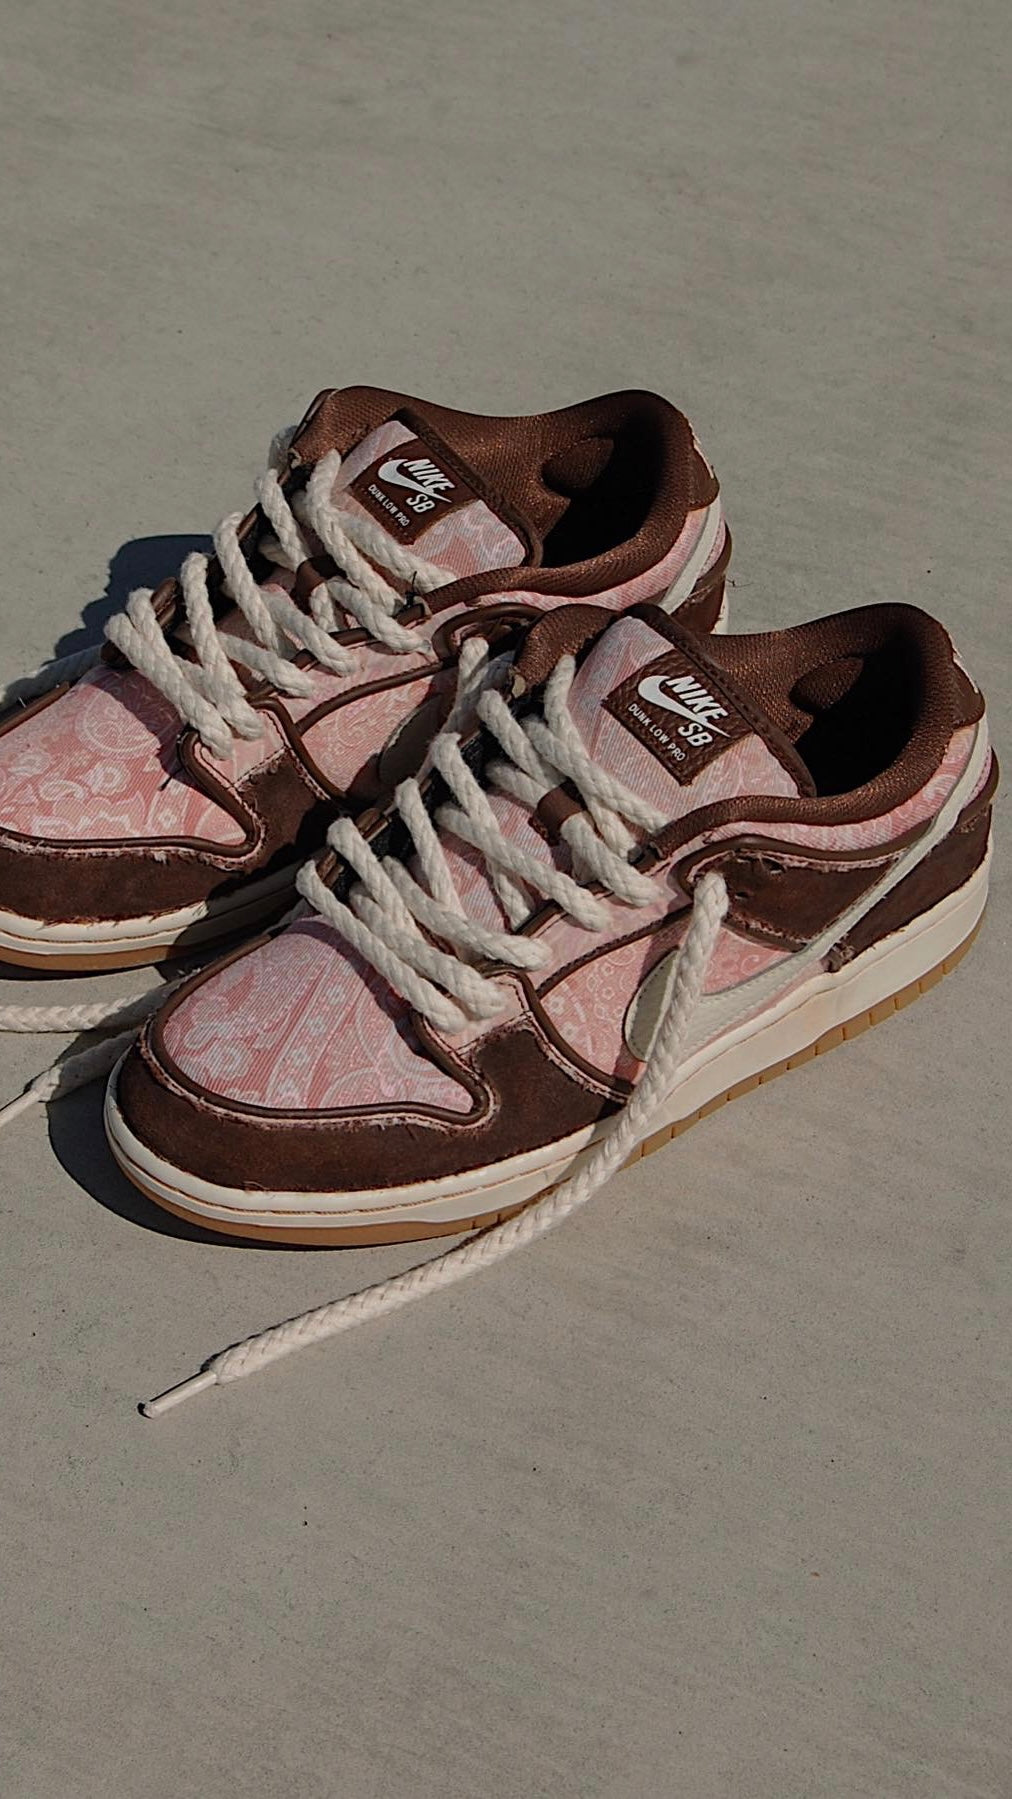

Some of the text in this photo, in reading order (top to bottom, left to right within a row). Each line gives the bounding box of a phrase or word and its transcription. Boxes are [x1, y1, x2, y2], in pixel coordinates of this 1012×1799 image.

[402, 459, 455, 493] NIKE
[368, 484, 410, 527] DUNK LOW PRO
[405, 493, 435, 513] SB
[665, 675, 729, 722] NIKE
[628, 703, 686, 761] DUNK LOW PRO
[677, 722, 713, 747] SB
